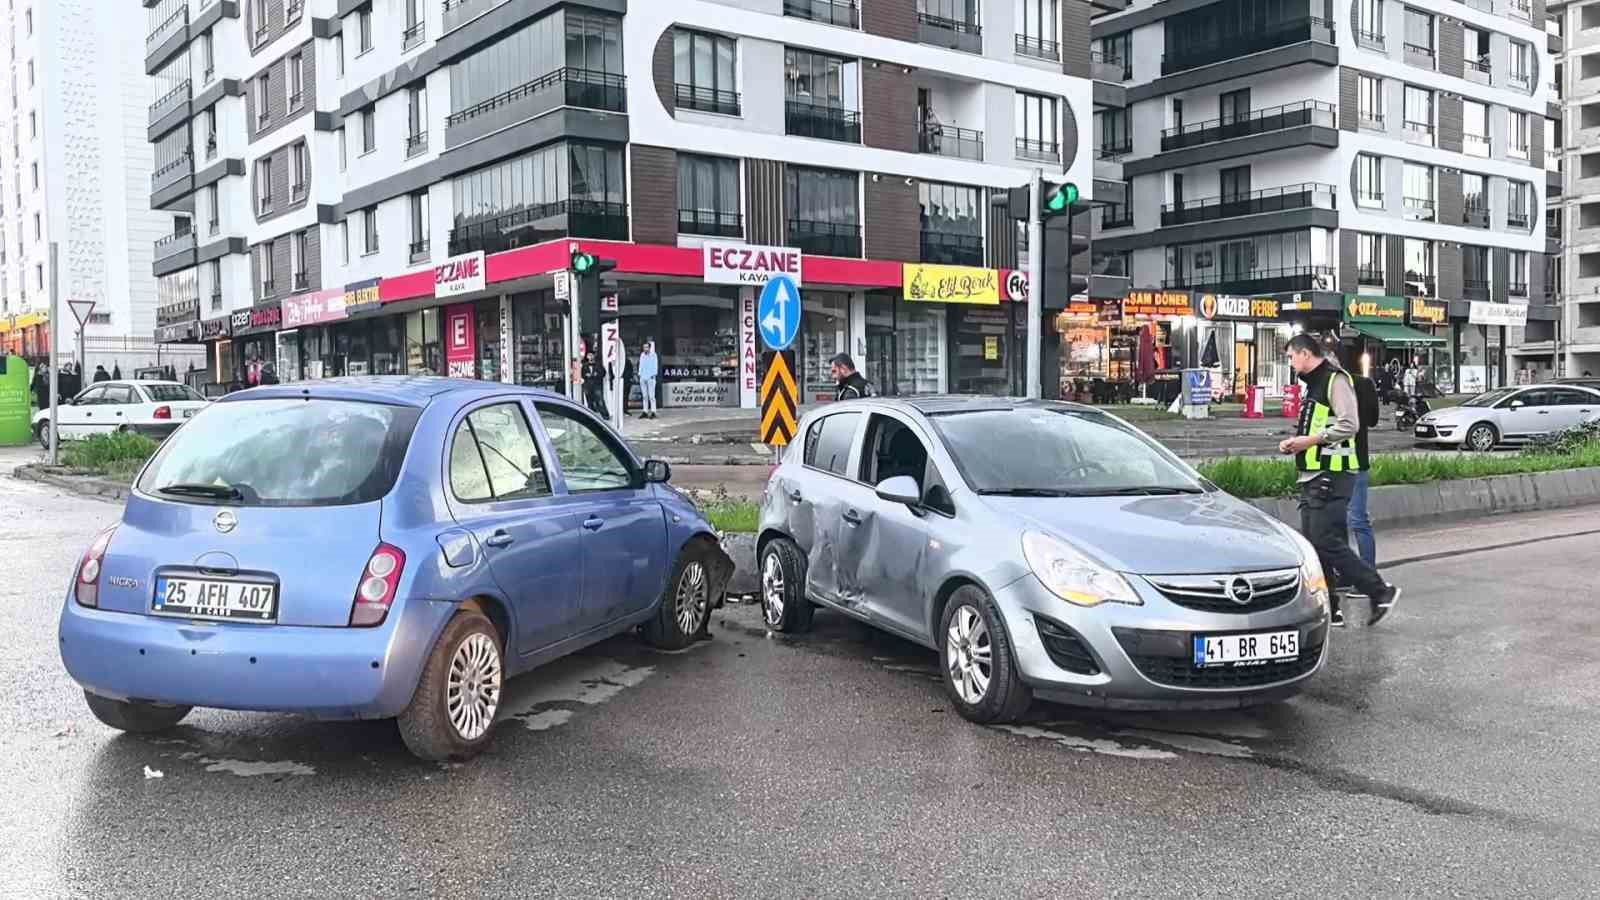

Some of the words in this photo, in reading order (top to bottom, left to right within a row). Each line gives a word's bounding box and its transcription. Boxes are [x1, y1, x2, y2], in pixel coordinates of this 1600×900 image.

[435, 257, 480, 284] ECZANE
[709, 247, 799, 273] ECZANE
[450, 282, 465, 291] KAYA
[739, 272, 769, 282] KAYA
[1154, 290, 1188, 306] DÖNER
[1251, 299, 1280, 318] PERDE
[454, 320, 466, 346] E
[744, 300, 754, 389] ECZANE
[166, 582, 186, 604] 25
[197, 583, 229, 607] AFH
[238, 586, 272, 610] 407
[1206, 639, 1224, 659] 41
[1238, 637, 1257, 657] BR
[1270, 634, 1297, 655] 645
